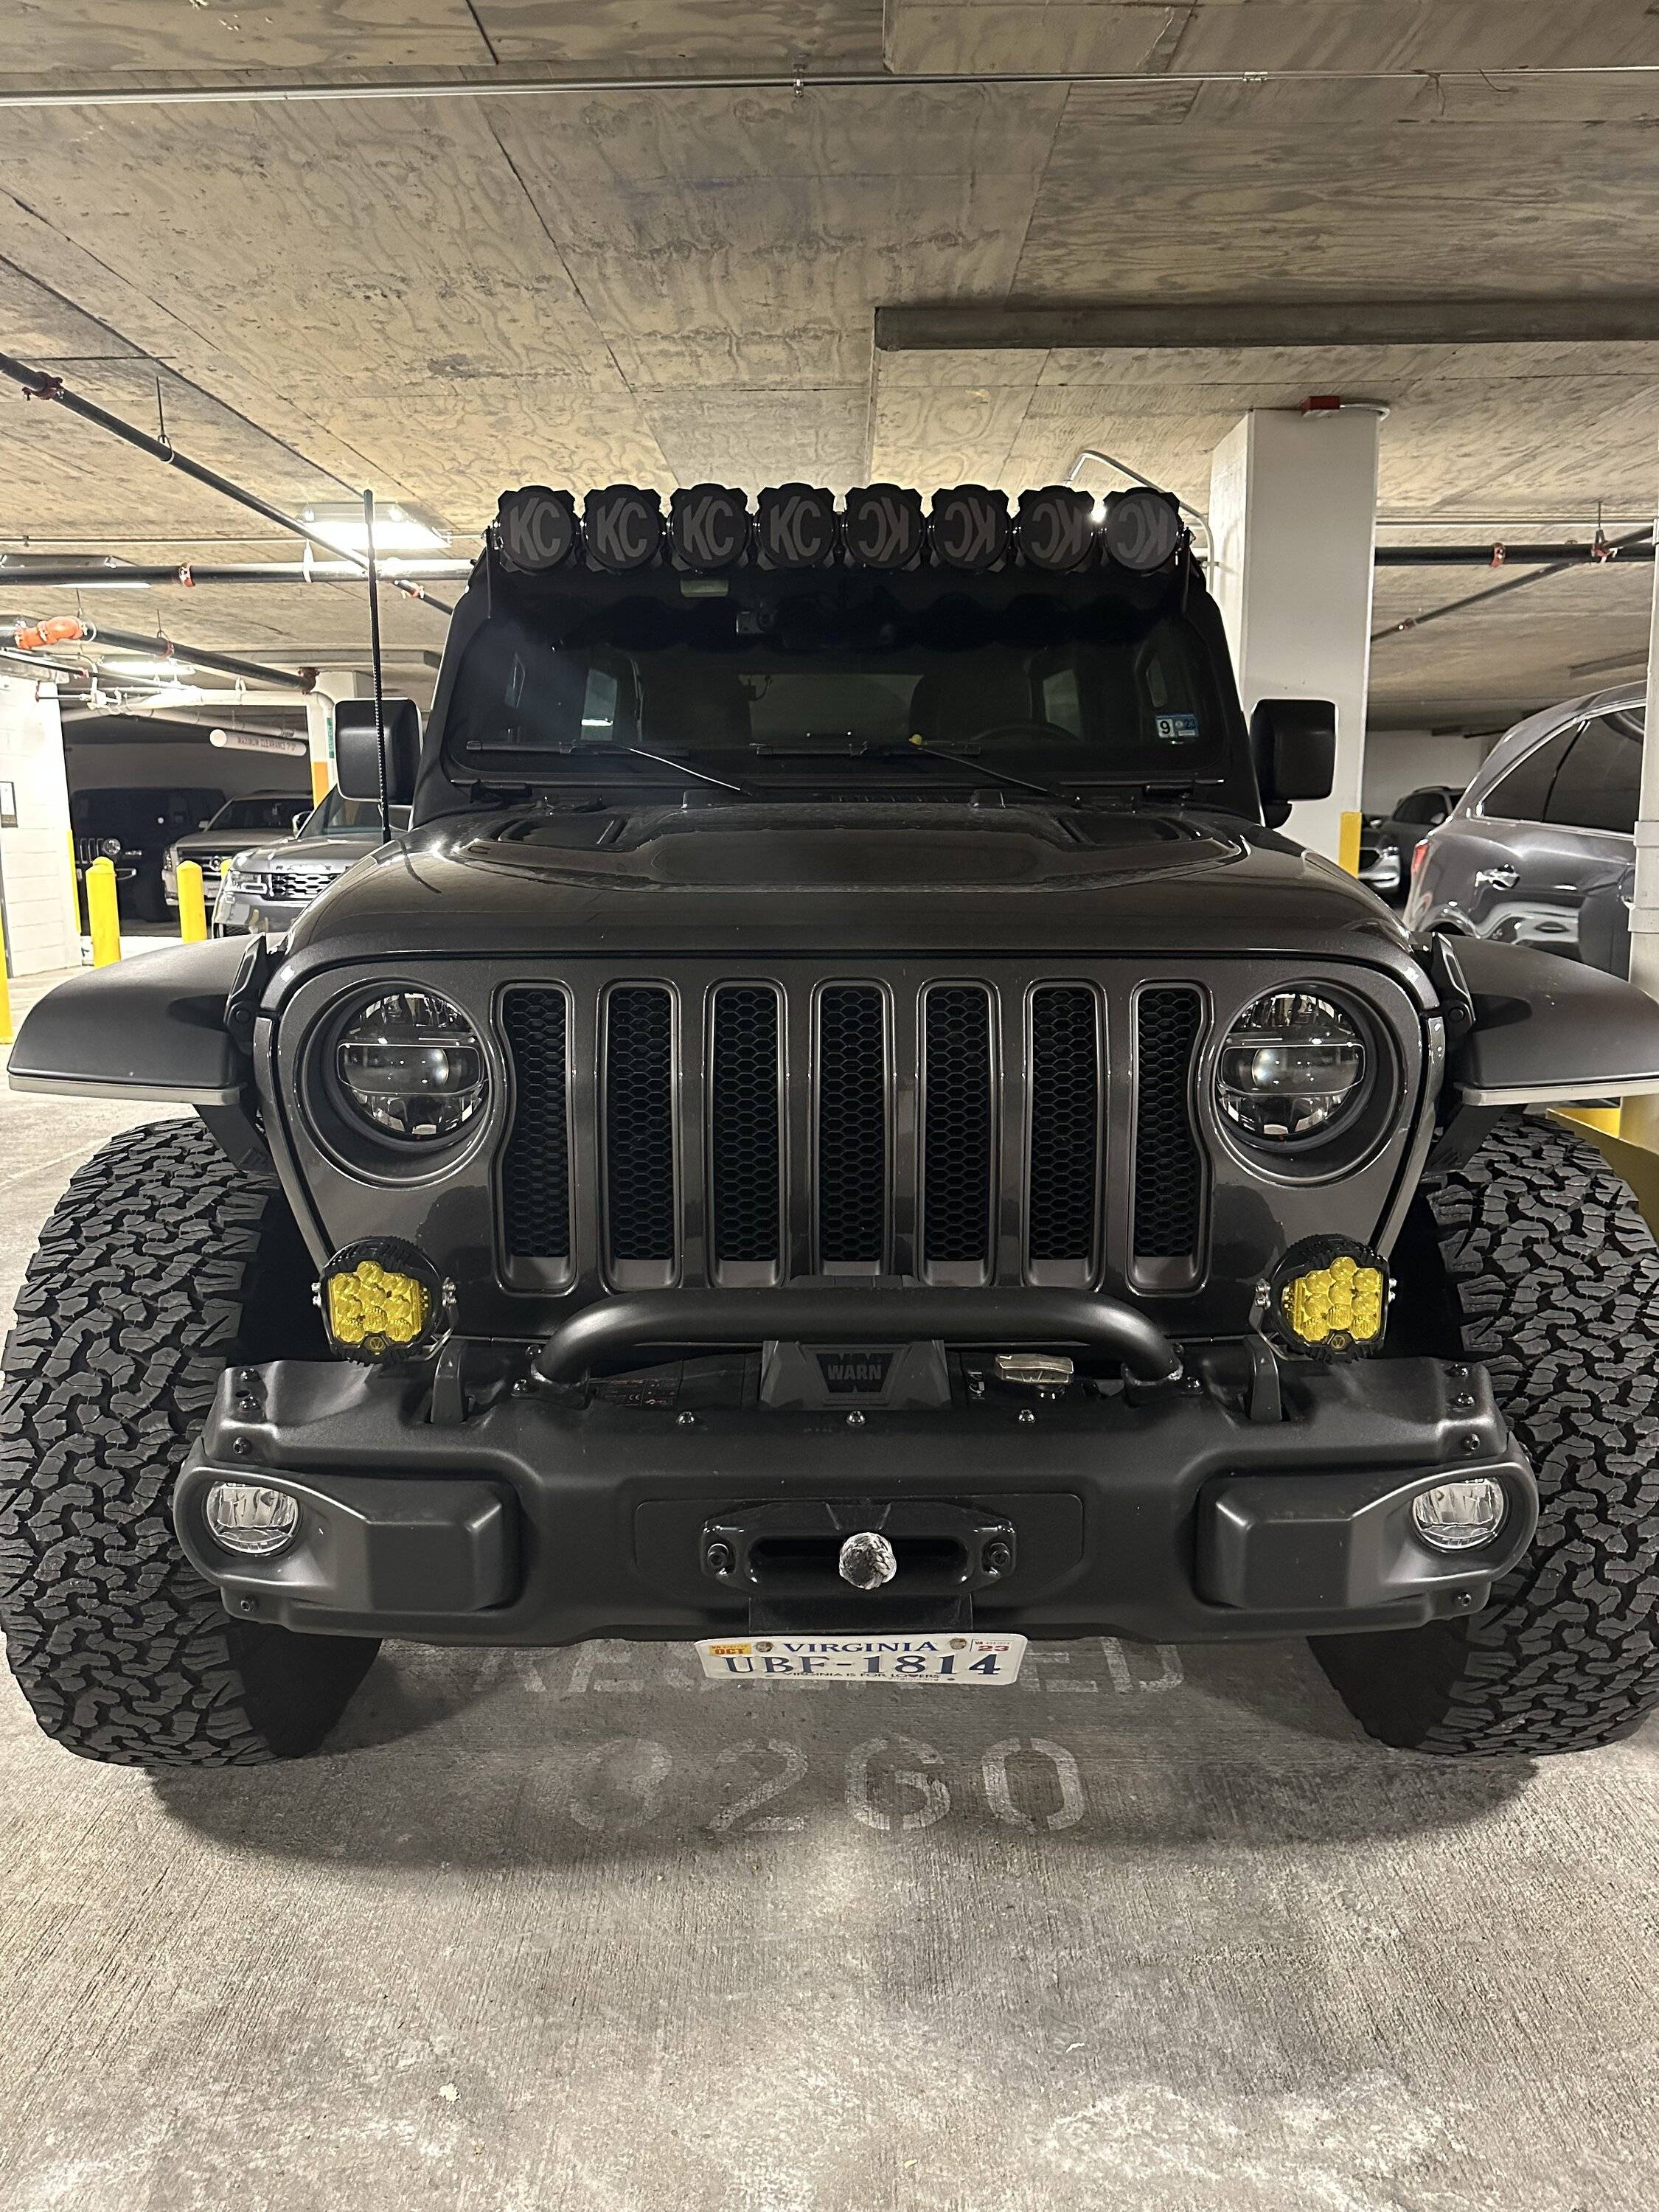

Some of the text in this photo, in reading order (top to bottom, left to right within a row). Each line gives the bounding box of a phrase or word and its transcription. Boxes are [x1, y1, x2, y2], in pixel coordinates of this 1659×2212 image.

[510, 497, 561, 561] KC
[597, 497, 647, 561] KC
[683, 496, 734, 560] KC
[770, 495, 821, 561] KC
[1160, 720, 1171, 734] 9
[827, 1364, 882, 1380] WARN
[723, 1653, 1001, 1675] UBF-1814
[782, 1641, 939, 1652] VIRGINIA
